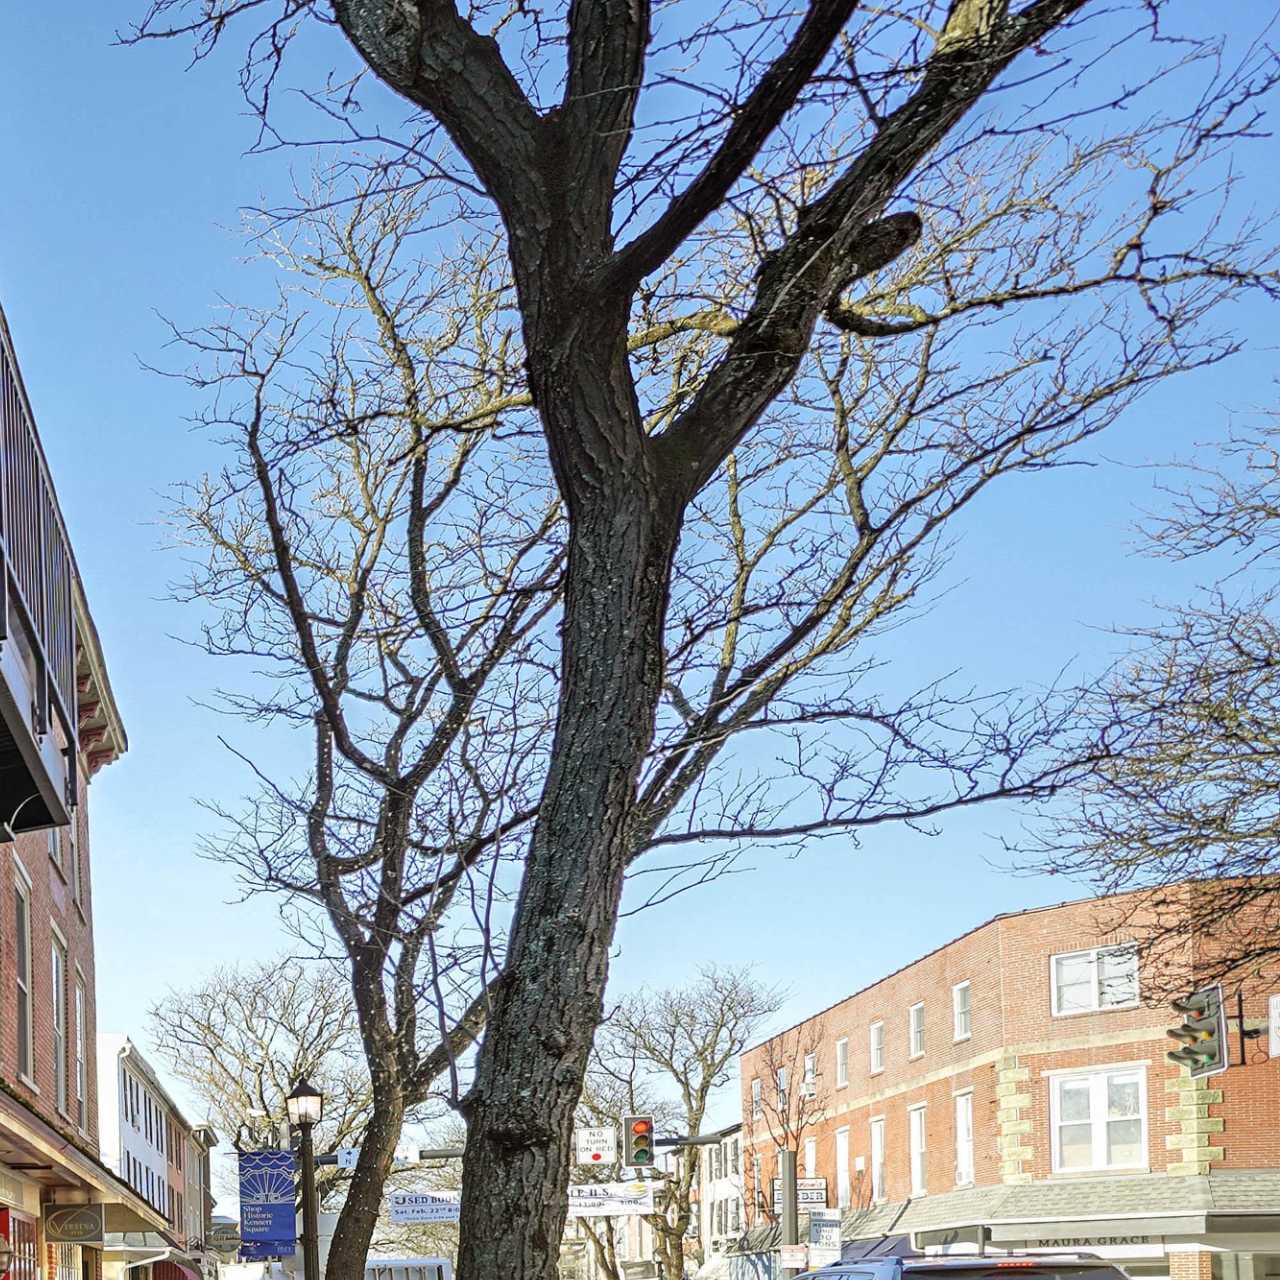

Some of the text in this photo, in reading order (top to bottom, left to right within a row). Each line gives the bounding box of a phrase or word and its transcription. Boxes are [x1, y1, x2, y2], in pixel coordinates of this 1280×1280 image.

[395, 1195, 428, 1205] USED
[243, 1212, 273, 1220] Historic
[1038, 1236, 1151, 1248] MAURA GRACE
